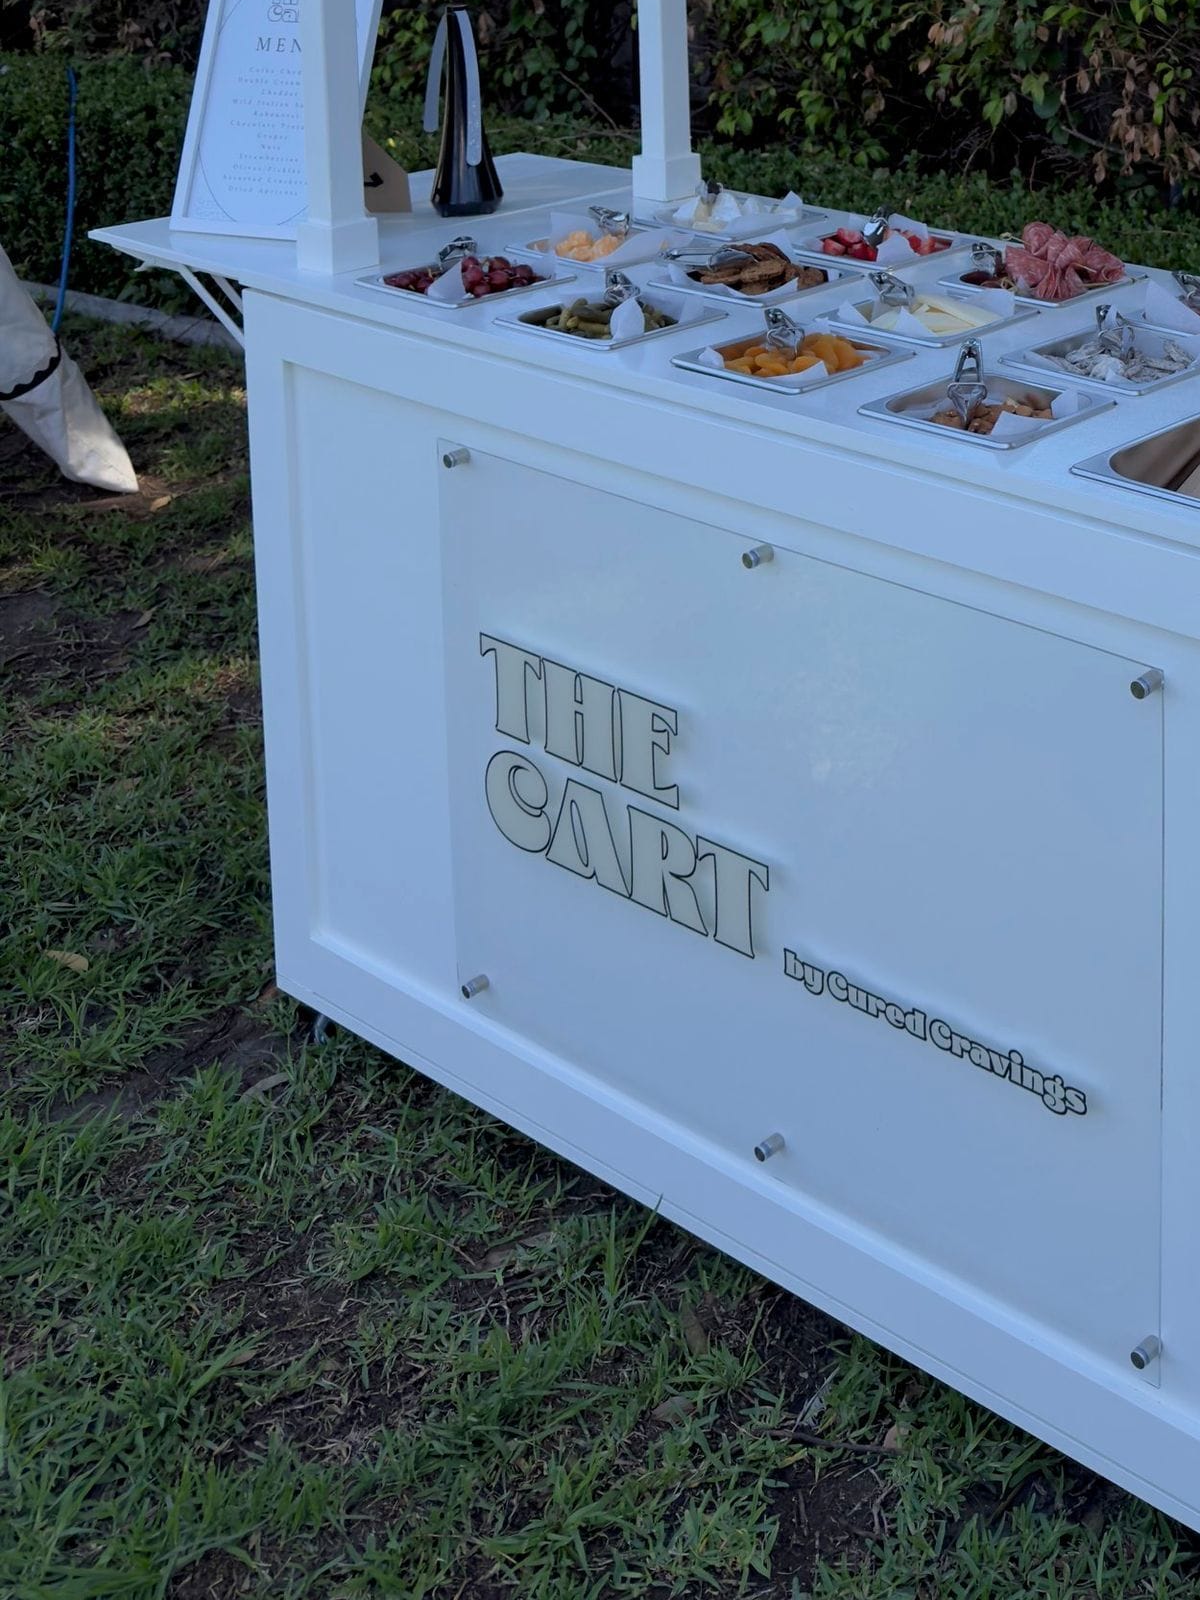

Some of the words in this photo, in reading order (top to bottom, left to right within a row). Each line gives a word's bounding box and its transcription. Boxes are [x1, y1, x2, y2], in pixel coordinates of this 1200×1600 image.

[255, 36, 303, 53] MEN
[267, 4, 300, 23] Ca
[479, 632, 680, 811] THE
[484, 748, 769, 960] CART
[783, 948, 825, 995] by
[826, 970, 927, 1041] Cured
[929, 1018, 1087, 1115] Cravings
